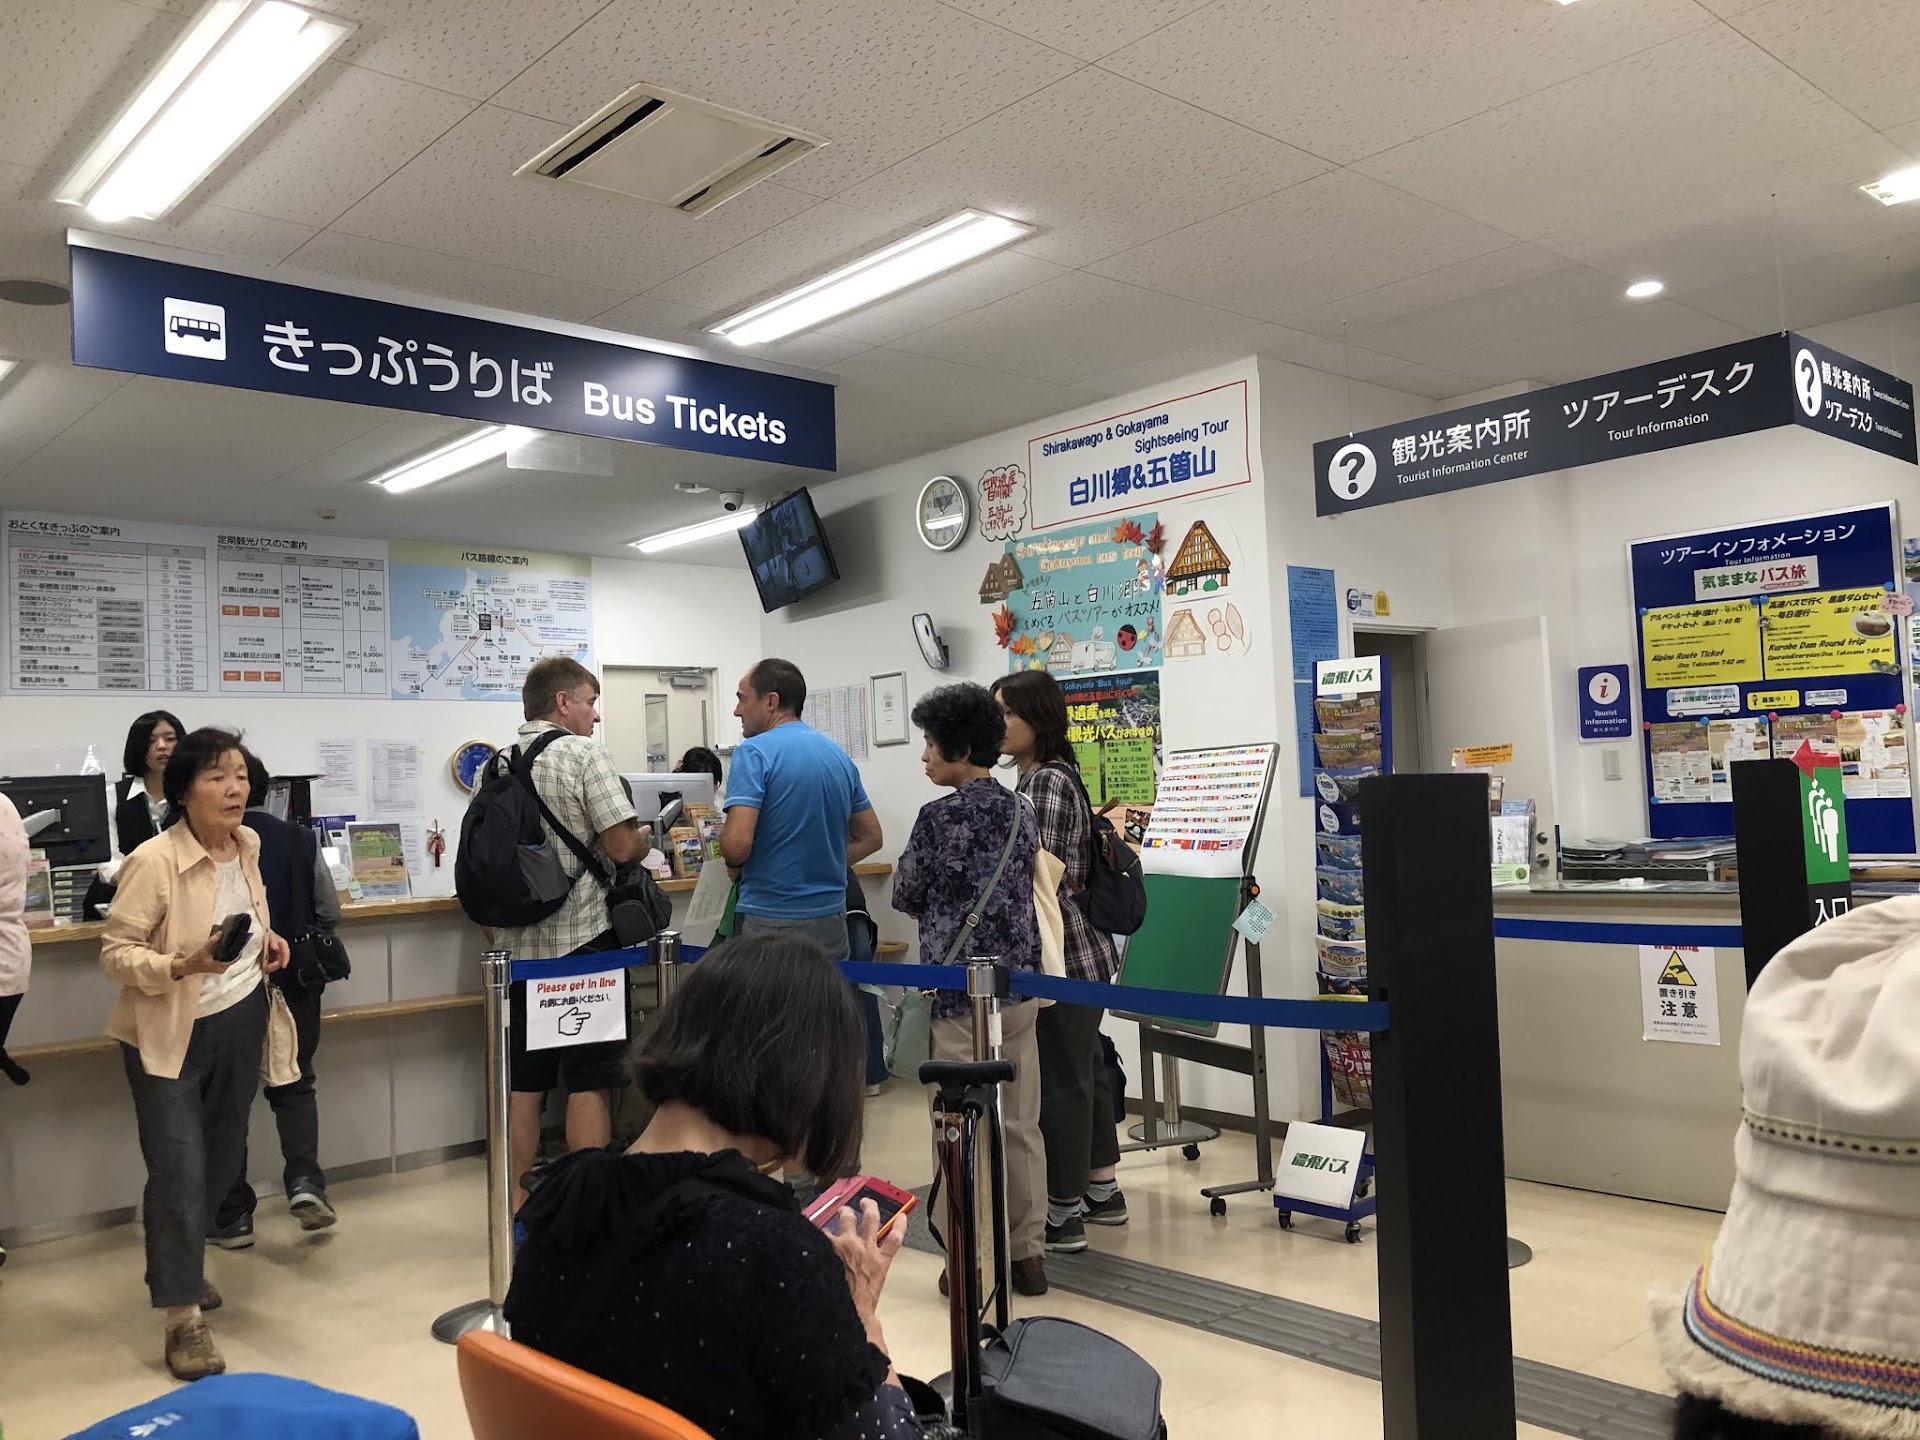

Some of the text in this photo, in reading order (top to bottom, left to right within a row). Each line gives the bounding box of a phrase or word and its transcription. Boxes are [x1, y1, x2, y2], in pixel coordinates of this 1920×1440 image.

[263, 320, 554, 405] きっぷうりば
[1821, 360, 1872, 402] 観光案内所
[583, 381, 787, 445] Bus Tickets
[1391, 361, 1754, 467] 観光案内所 ツアーデスク
[1825, 399, 1873, 433] ツアーデスク
[1043, 414, 1169, 457] Shirakawago & Gokayama
[1135, 419, 1229, 453] Sightseeing Tour
[1607, 411, 1709, 442] Tour Information
[1070, 445, 1216, 506] 白川郷&五箇山
[1396, 450, 1528, 485] Tourist Information Center
[8, 519, 121, 537] おとくなきっぷのご案内
[1088, 526, 1112, 546] and
[217, 534, 308, 550] 定期観光バスのご案内
[1660, 524, 1856, 565] ツアーインフォメーション
[461, 552, 529, 566] バス路線のご案内
[1038, 545, 1146, 573] Gokayama bus tour
[1725, 552, 1791, 566] Tour Information
[1702, 564, 1807, 590] 気ままなバス旅
[1676, 651, 1698, 660] Route
[1700, 648, 1725, 658] Ticket
[1800, 641, 1817, 650] Dam
[1819, 639, 1846, 648] Round
[1321, 668, 1374, 685] 濃飛バス
[1585, 718, 1628, 726] Information
[1594, 709, 1618, 717] Tourist
[537, 977, 617, 993] Please get in line
[1659, 987, 1697, 1000] 置き引き
[1660, 1000, 1698, 1018] 注意
[1291, 1152, 1350, 1175] 濃飛バス
